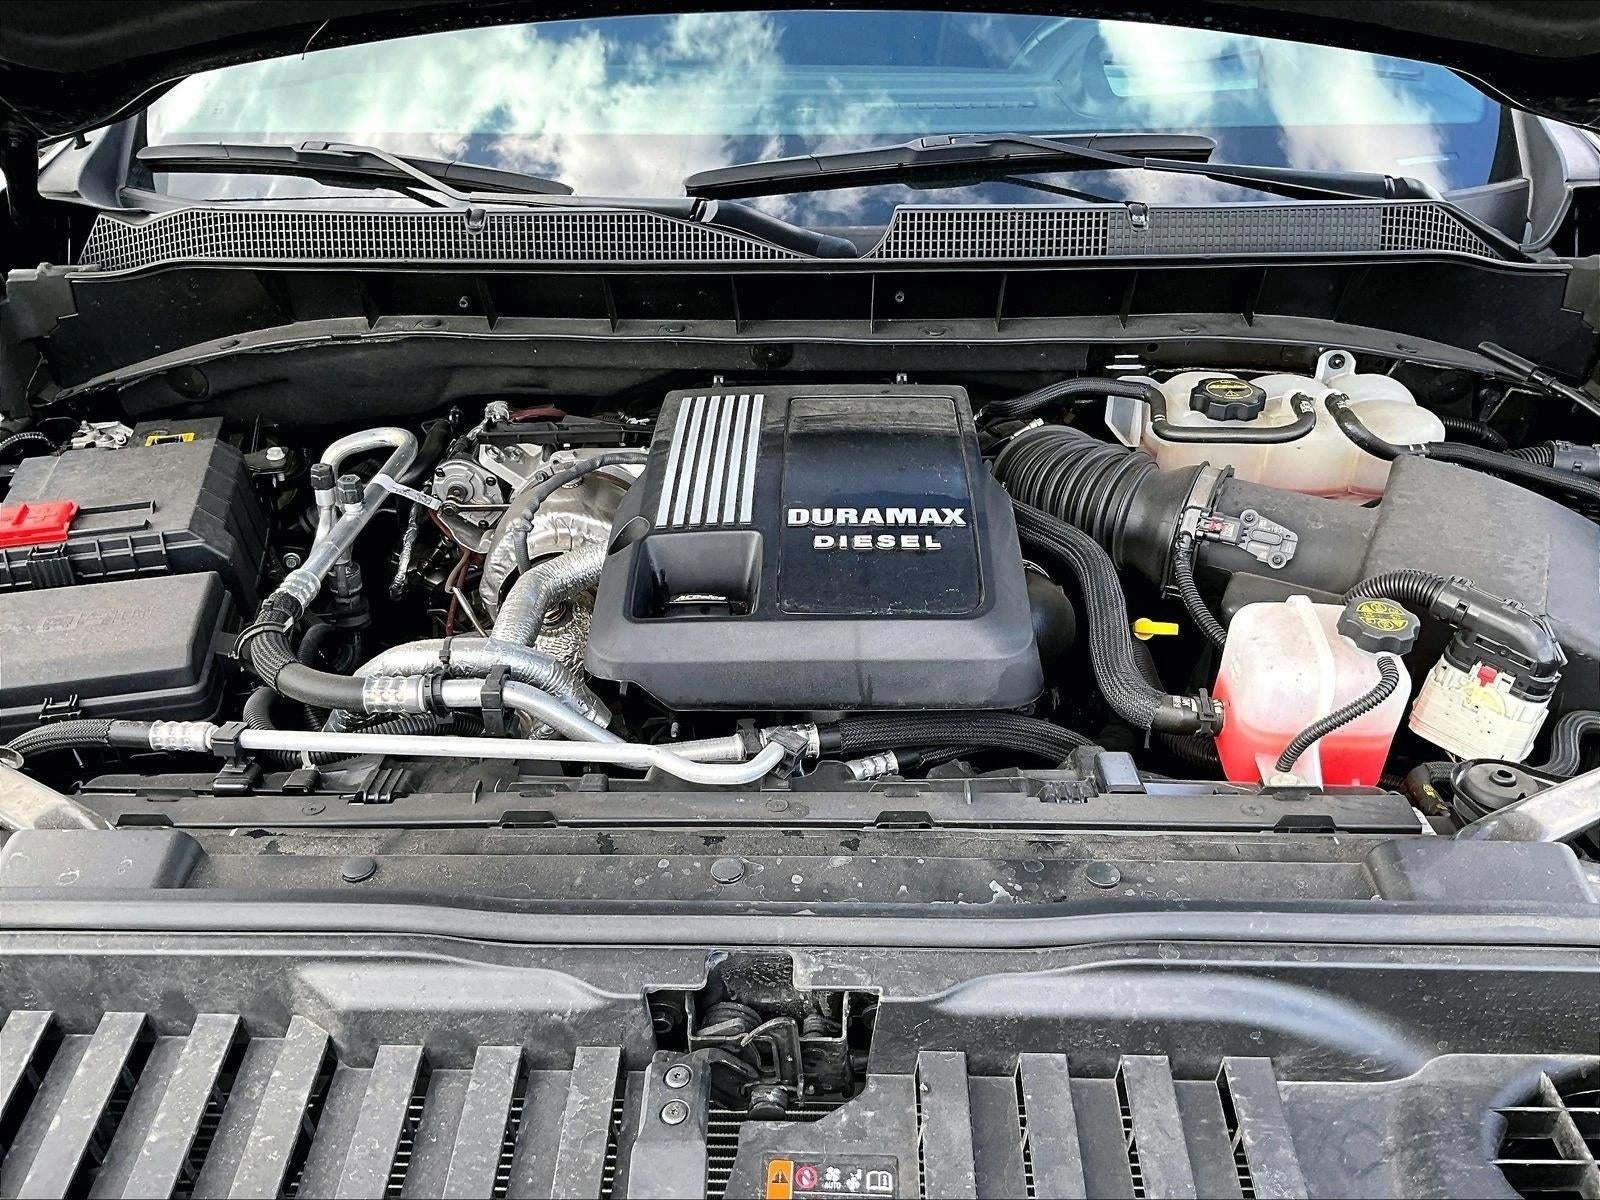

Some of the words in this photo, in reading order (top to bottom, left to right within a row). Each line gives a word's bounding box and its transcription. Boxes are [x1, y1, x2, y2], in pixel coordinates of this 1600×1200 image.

[787, 508, 966, 527] DURAMAX
[813, 535, 941, 550] DIESEL
[824, 1181, 841, 1190] AUTO
